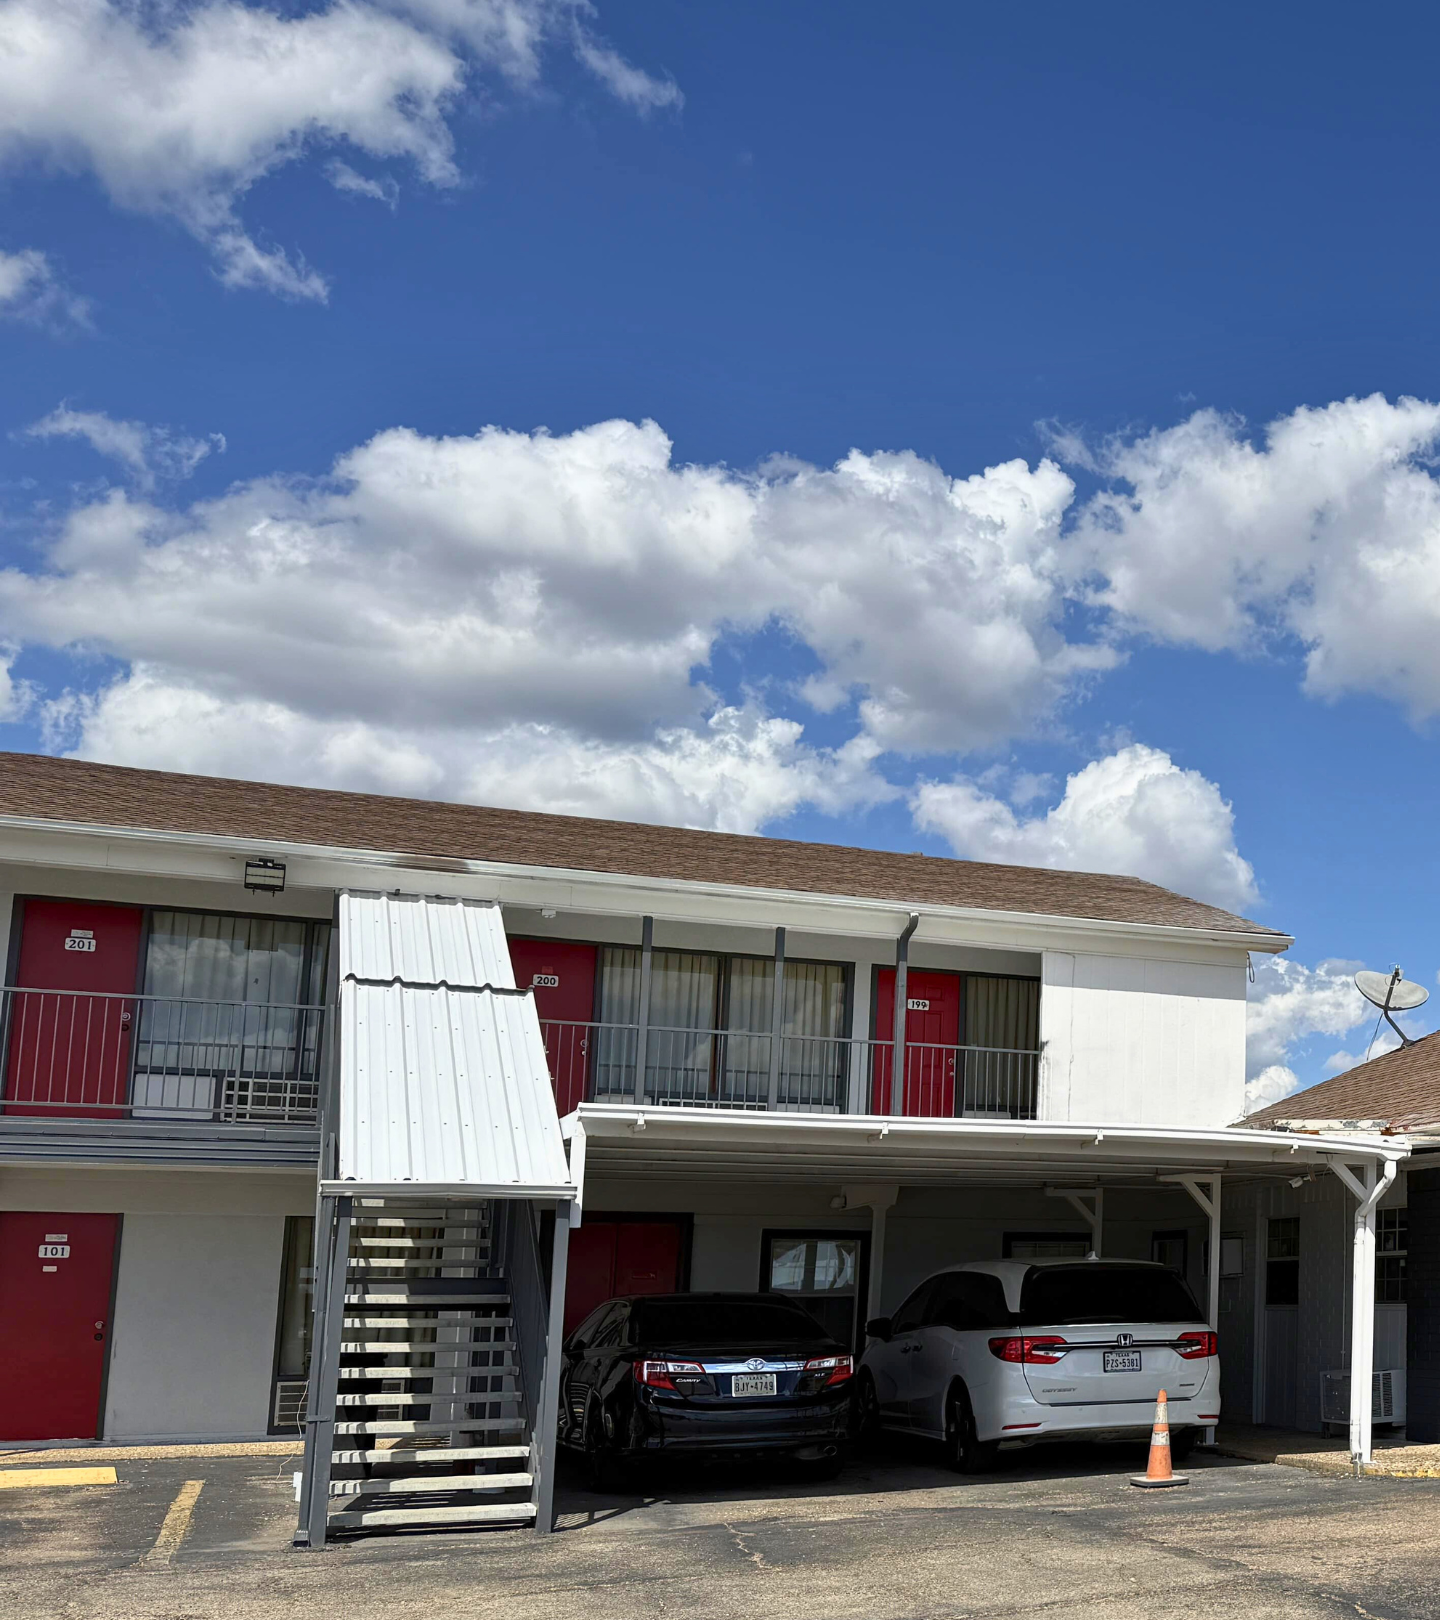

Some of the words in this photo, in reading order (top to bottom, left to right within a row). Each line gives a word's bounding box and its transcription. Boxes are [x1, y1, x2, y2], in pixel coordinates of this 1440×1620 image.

[69, 939, 92, 951] 201
[536, 976, 556, 985] 200
[911, 1000, 927, 1009] 199
[43, 1246, 65, 1257] 101
